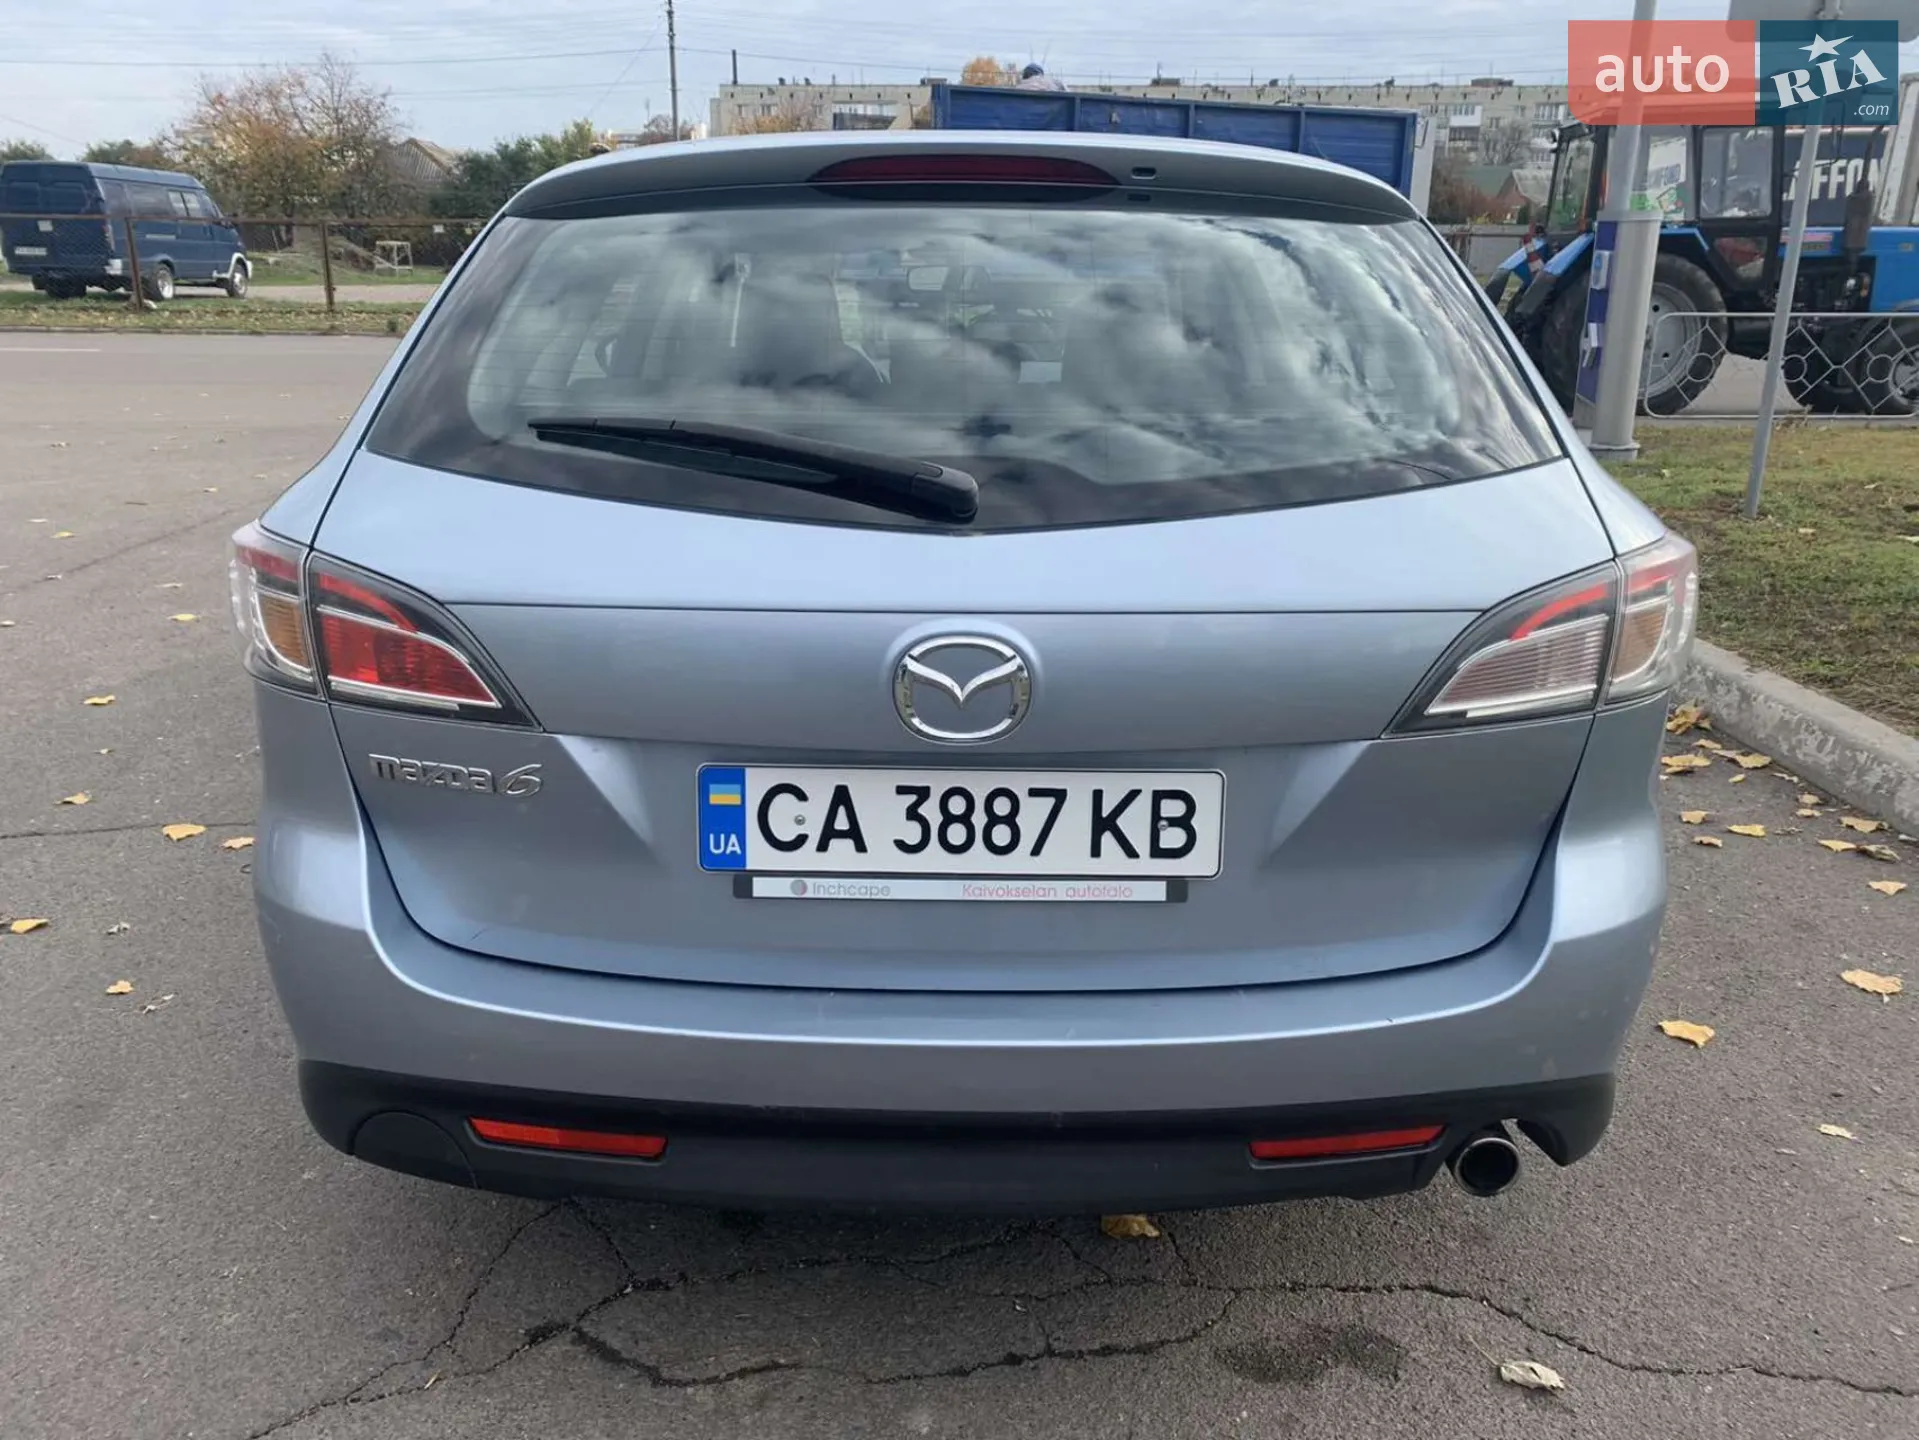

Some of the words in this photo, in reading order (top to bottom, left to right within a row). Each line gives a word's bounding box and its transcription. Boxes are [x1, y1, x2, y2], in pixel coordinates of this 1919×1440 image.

[368, 753, 497, 794] mazda
[499, 763, 544, 797] 6
[756, 782, 868, 853] CA
[893, 784, 1068, 856] 3887
[1089, 788, 1197, 860] KB
[709, 833, 742, 855] UA
[812, 881, 891, 899] Inchcape
